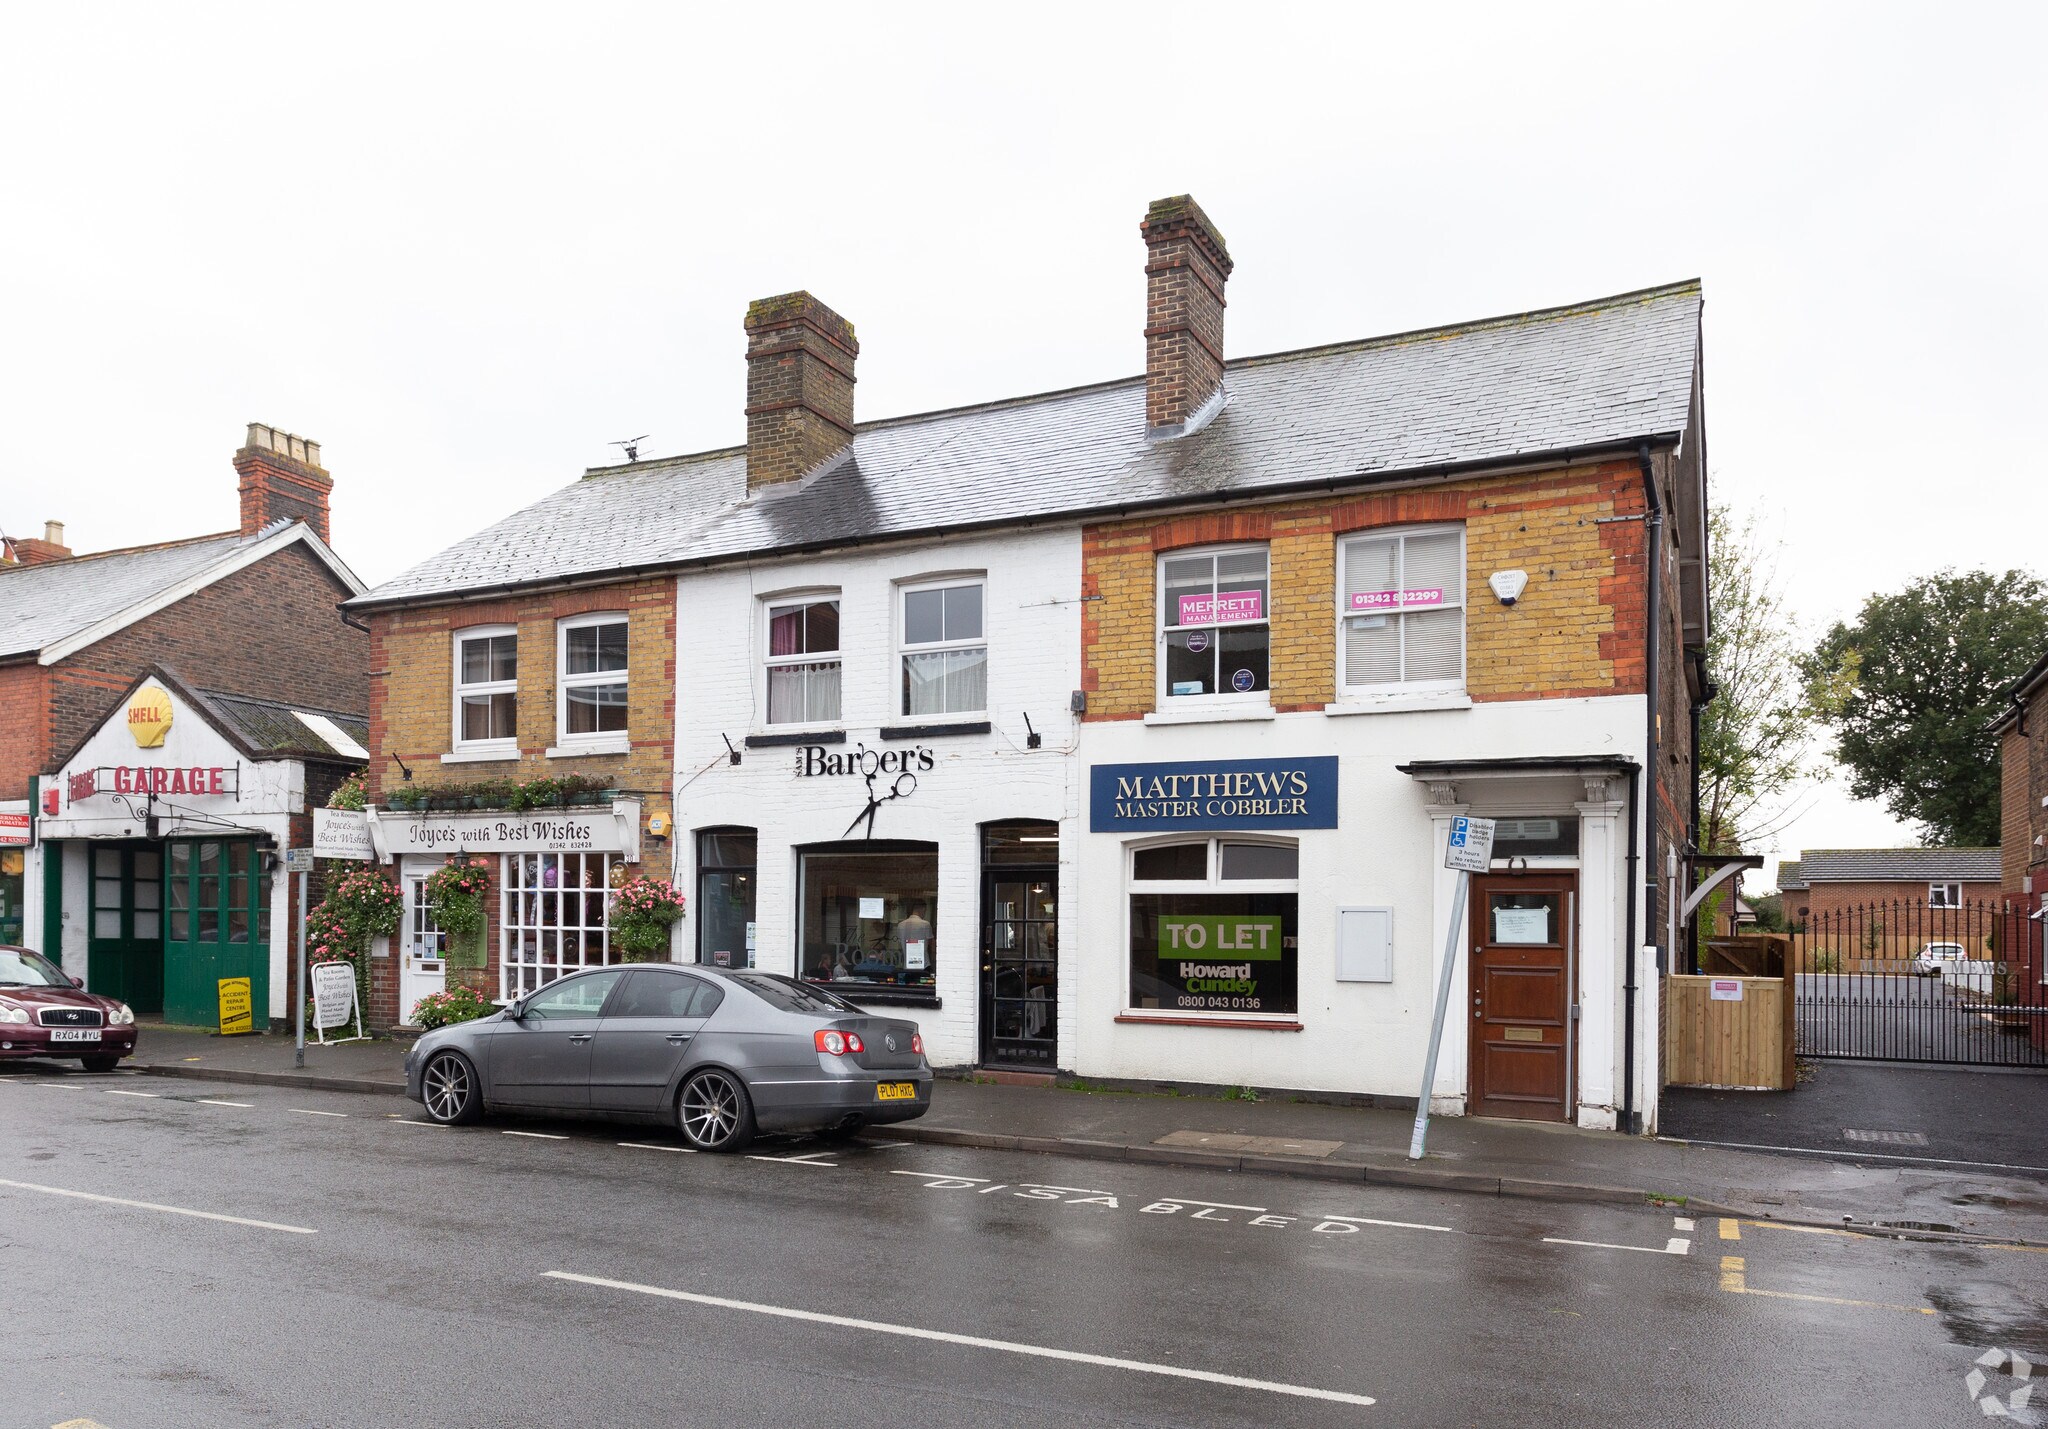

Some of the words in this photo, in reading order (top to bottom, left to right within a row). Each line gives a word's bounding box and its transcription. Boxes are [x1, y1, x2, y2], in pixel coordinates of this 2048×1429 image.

[1183, 598, 1257, 613] MERRETT
[1355, 594, 1390, 604] 01342
[128, 707, 161, 723] SHELL
[803, 742, 934, 777] Barber's
[114, 765, 223, 795] GARAGE
[1115, 771, 1308, 799] MATTHEWS
[1114, 801, 1201, 818] MASTER
[1206, 798, 1308, 816] COBBLER
[324, 820, 351, 832] Joyce's
[410, 824, 456, 848] Joyce's
[461, 827, 490, 842] with
[495, 822, 529, 841] Best
[532, 821, 590, 840] Wishes
[1469, 823, 1493, 831] Disabled
[318, 832, 337, 843] Best
[340, 833, 370, 845] Wishes
[1166, 924, 1207, 949] TO
[1217, 924, 1273, 949] LET
[1180, 962, 1251, 979] Howard
[1859, 959, 1932, 973] MAJORS
[1951, 961, 2007, 974] MEWS
[1186, 978, 1258, 996] Cundey
[1178, 996, 1204, 1008] 0800
[1208, 997, 1229, 1008] 043
[1232, 998, 1260, 1009] 0136
[922, 1179, 1361, 1235] DISABLED
